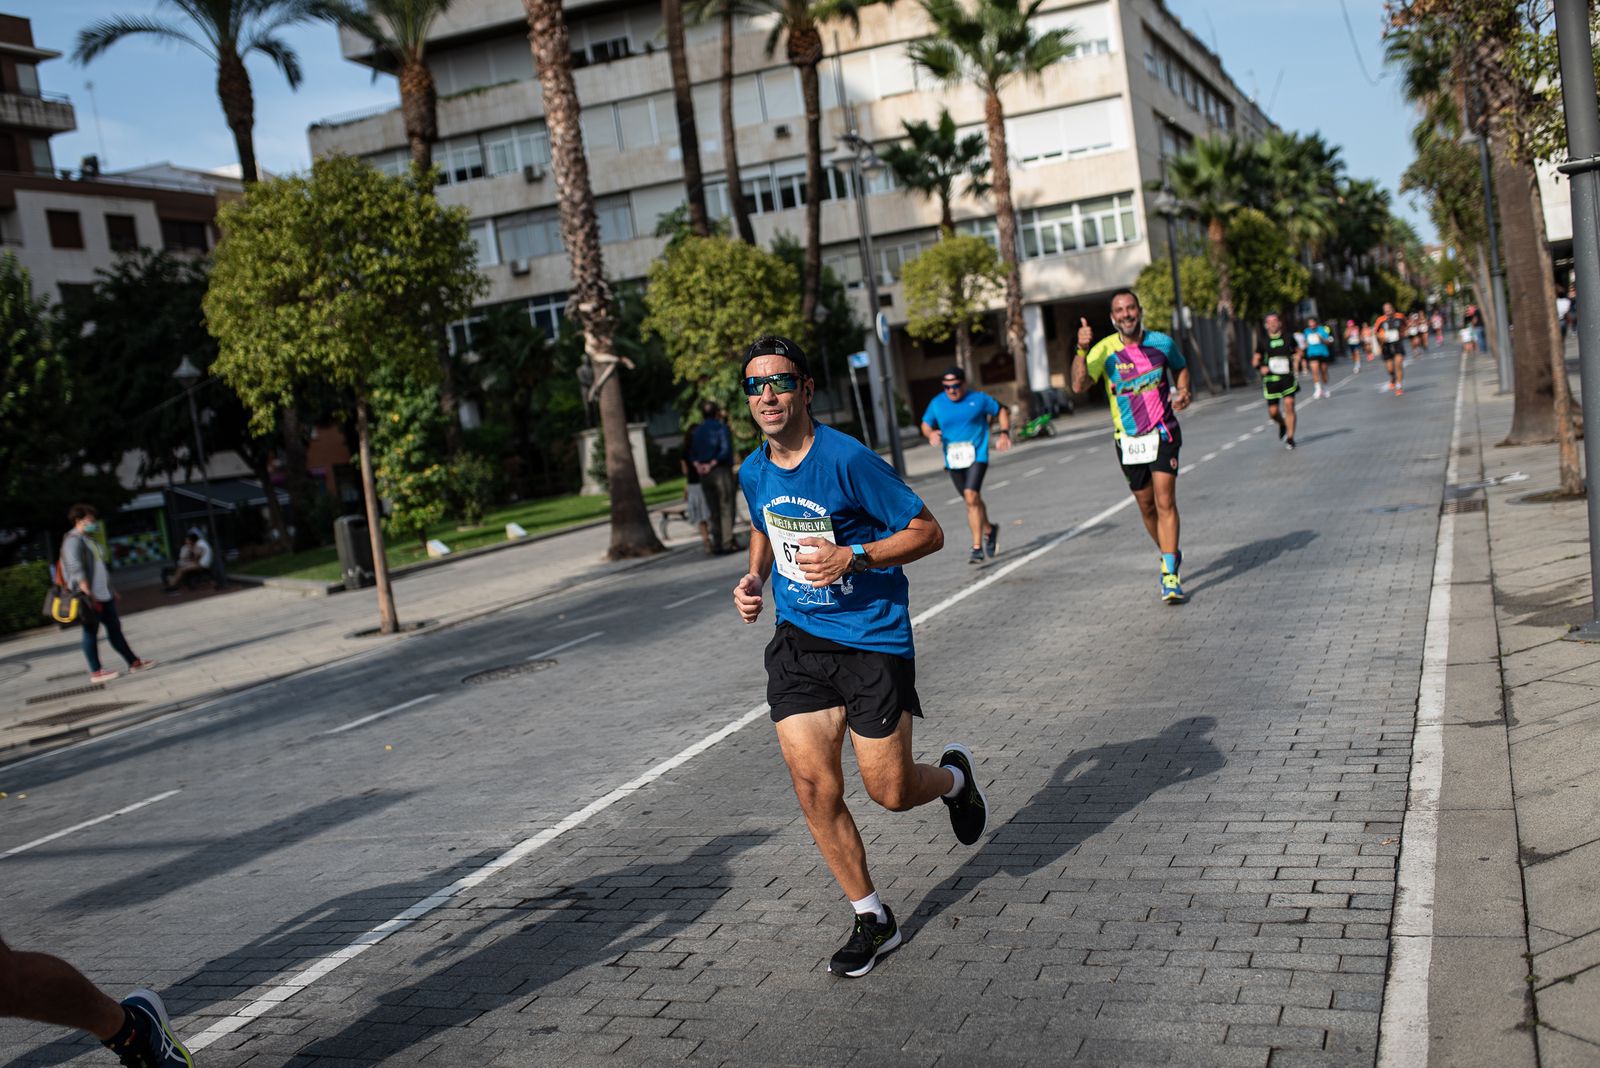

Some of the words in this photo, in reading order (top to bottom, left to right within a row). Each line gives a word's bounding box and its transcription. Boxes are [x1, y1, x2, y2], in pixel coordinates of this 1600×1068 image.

[791, 496, 796, 504] A
[797, 497, 826, 517] HUELVA
[793, 521, 798, 531] A
[799, 521, 826, 531] HUELVA
